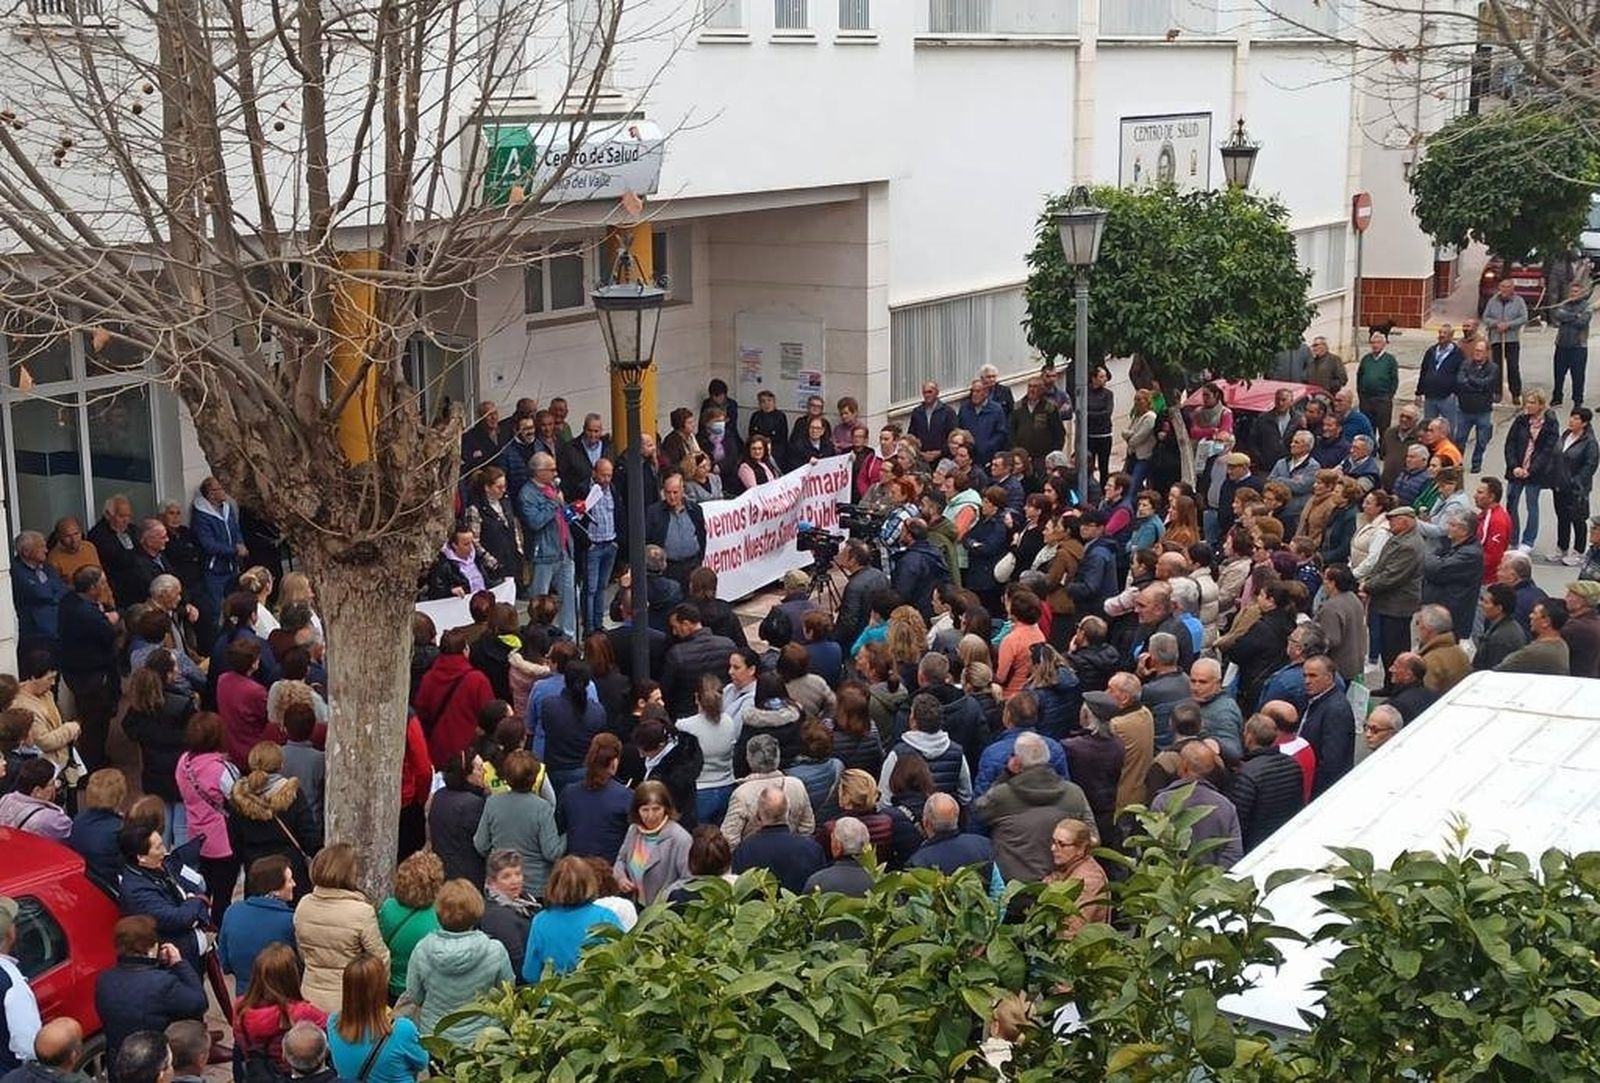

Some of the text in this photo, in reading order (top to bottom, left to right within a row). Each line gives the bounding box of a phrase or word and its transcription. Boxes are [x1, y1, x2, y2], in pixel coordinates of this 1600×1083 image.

[545, 145, 639, 166] Cenro de Salud
[571, 174, 586, 189] del
[749, 501, 759, 525] la
